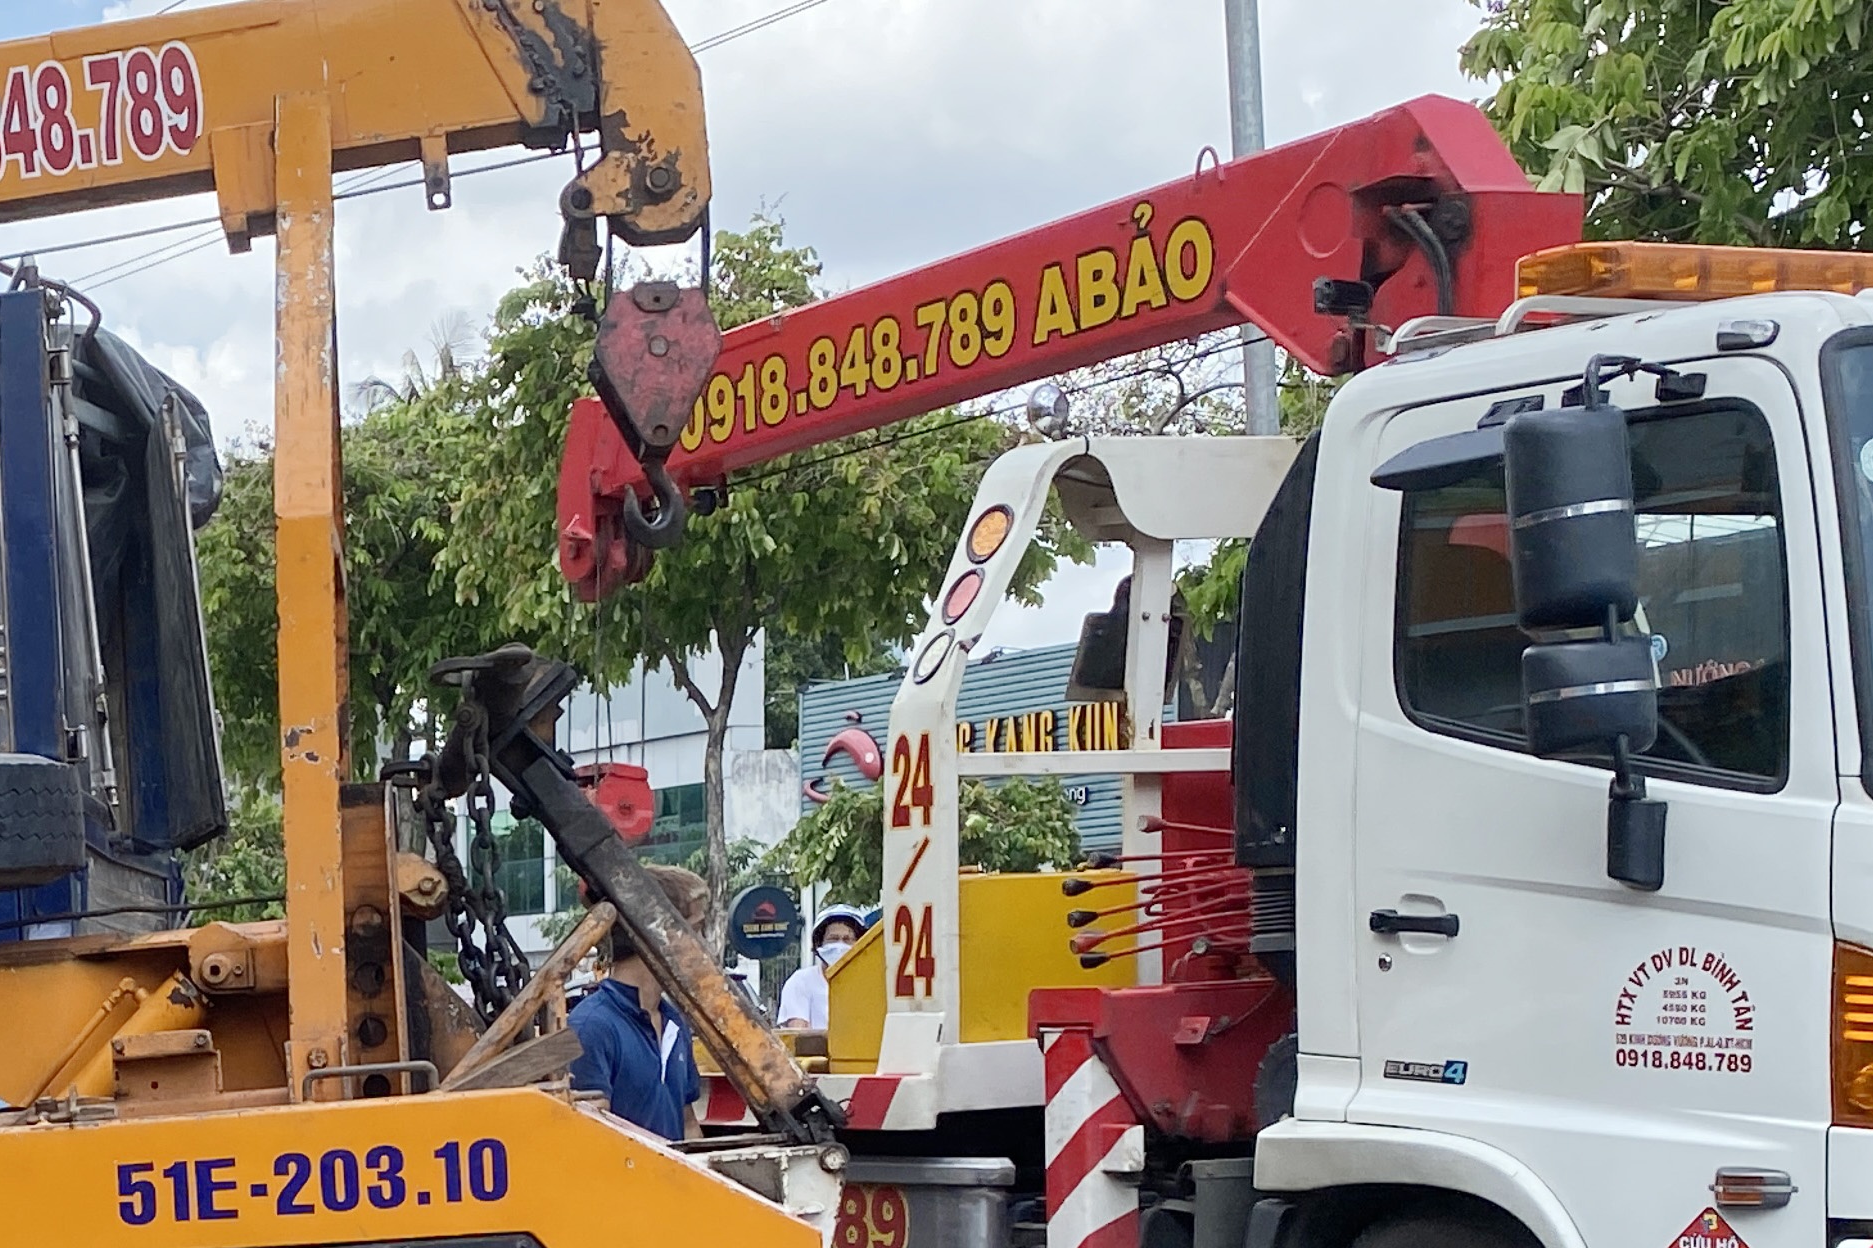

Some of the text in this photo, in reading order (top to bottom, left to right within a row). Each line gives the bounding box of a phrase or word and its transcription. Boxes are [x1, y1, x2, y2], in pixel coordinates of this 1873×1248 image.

[1032, 203, 1214, 347] ABẢO
[985, 709, 1054, 752] KANG
[1615, 946, 1756, 1031] HTX VT DV DL BÌNH TÂN
[1691, 990, 1707, 1000] KG
[1690, 1004, 1707, 1013] KG
[1690, 1016, 1706, 1026] KG
[1616, 1048, 1752, 1073] 0918.848.789
[117, 1138, 509, 1226] 51E-203.10
